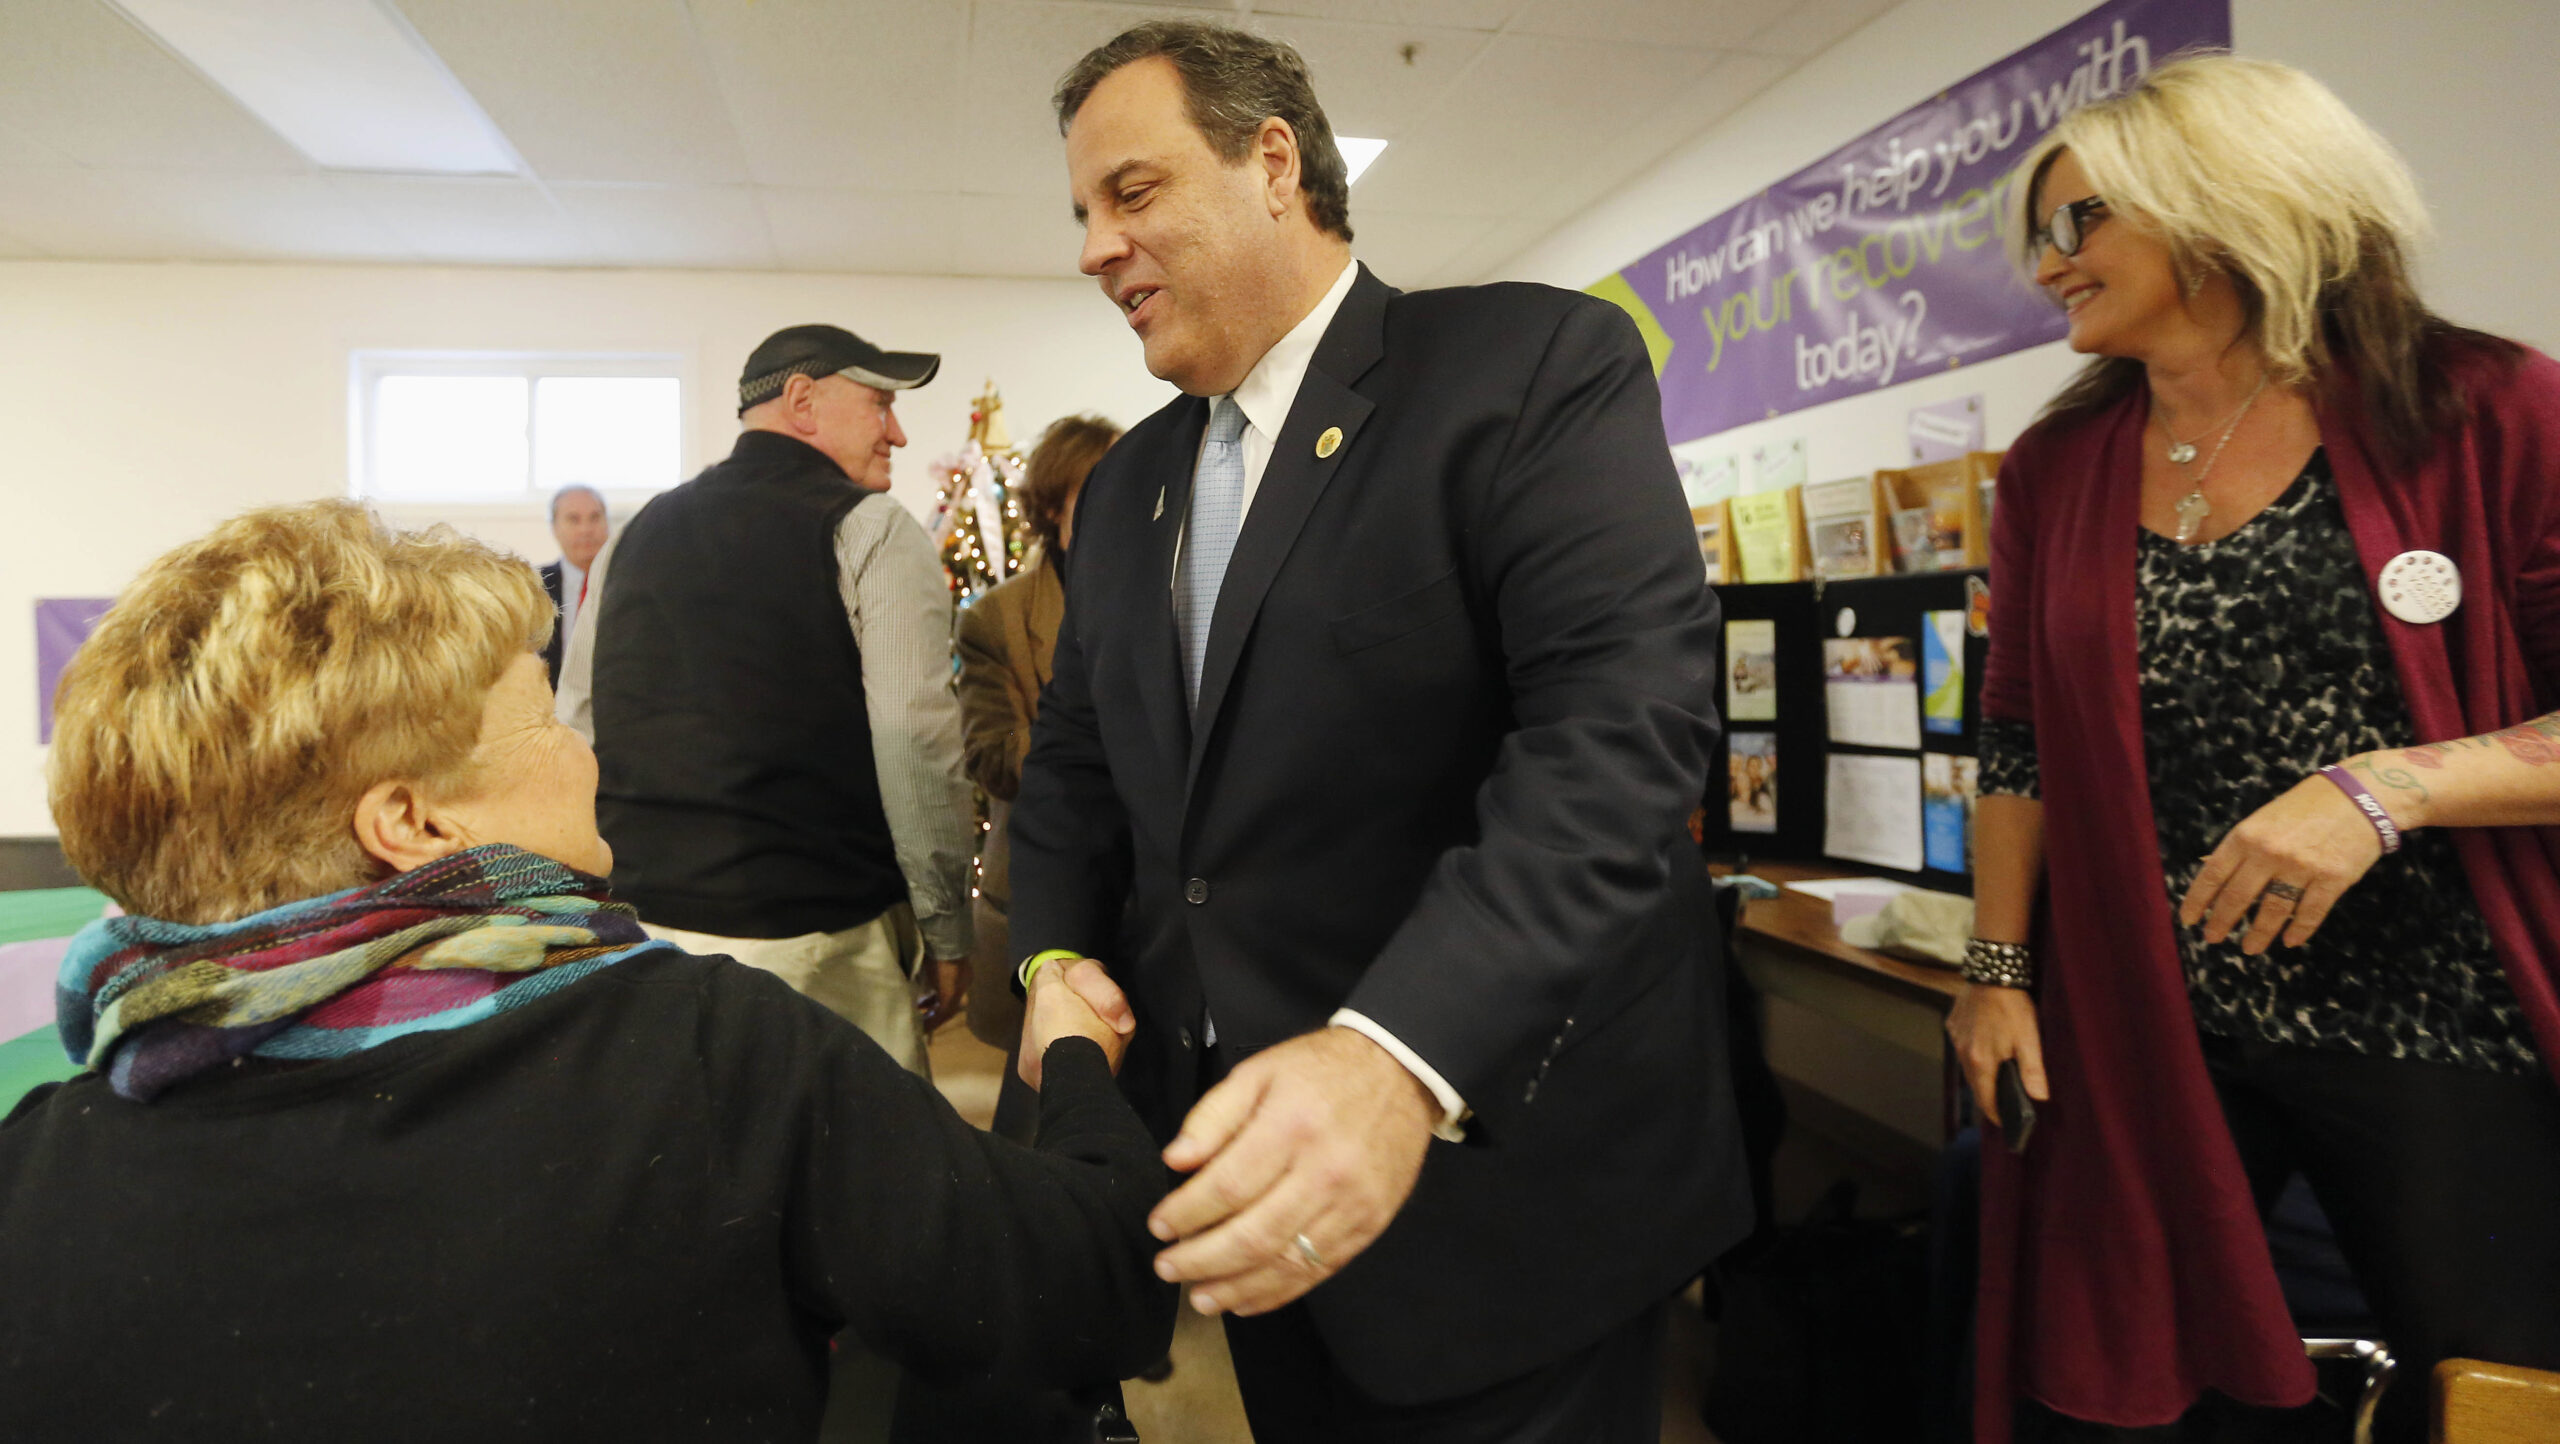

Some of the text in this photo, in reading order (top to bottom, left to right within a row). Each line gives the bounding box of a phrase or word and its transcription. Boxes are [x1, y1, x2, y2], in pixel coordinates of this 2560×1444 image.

[1666, 19, 2149, 303] How can we help you with
[1703, 172, 2015, 373] your recover
[1795, 289, 1927, 391] today?
[2353, 793, 2387, 817] NOT
